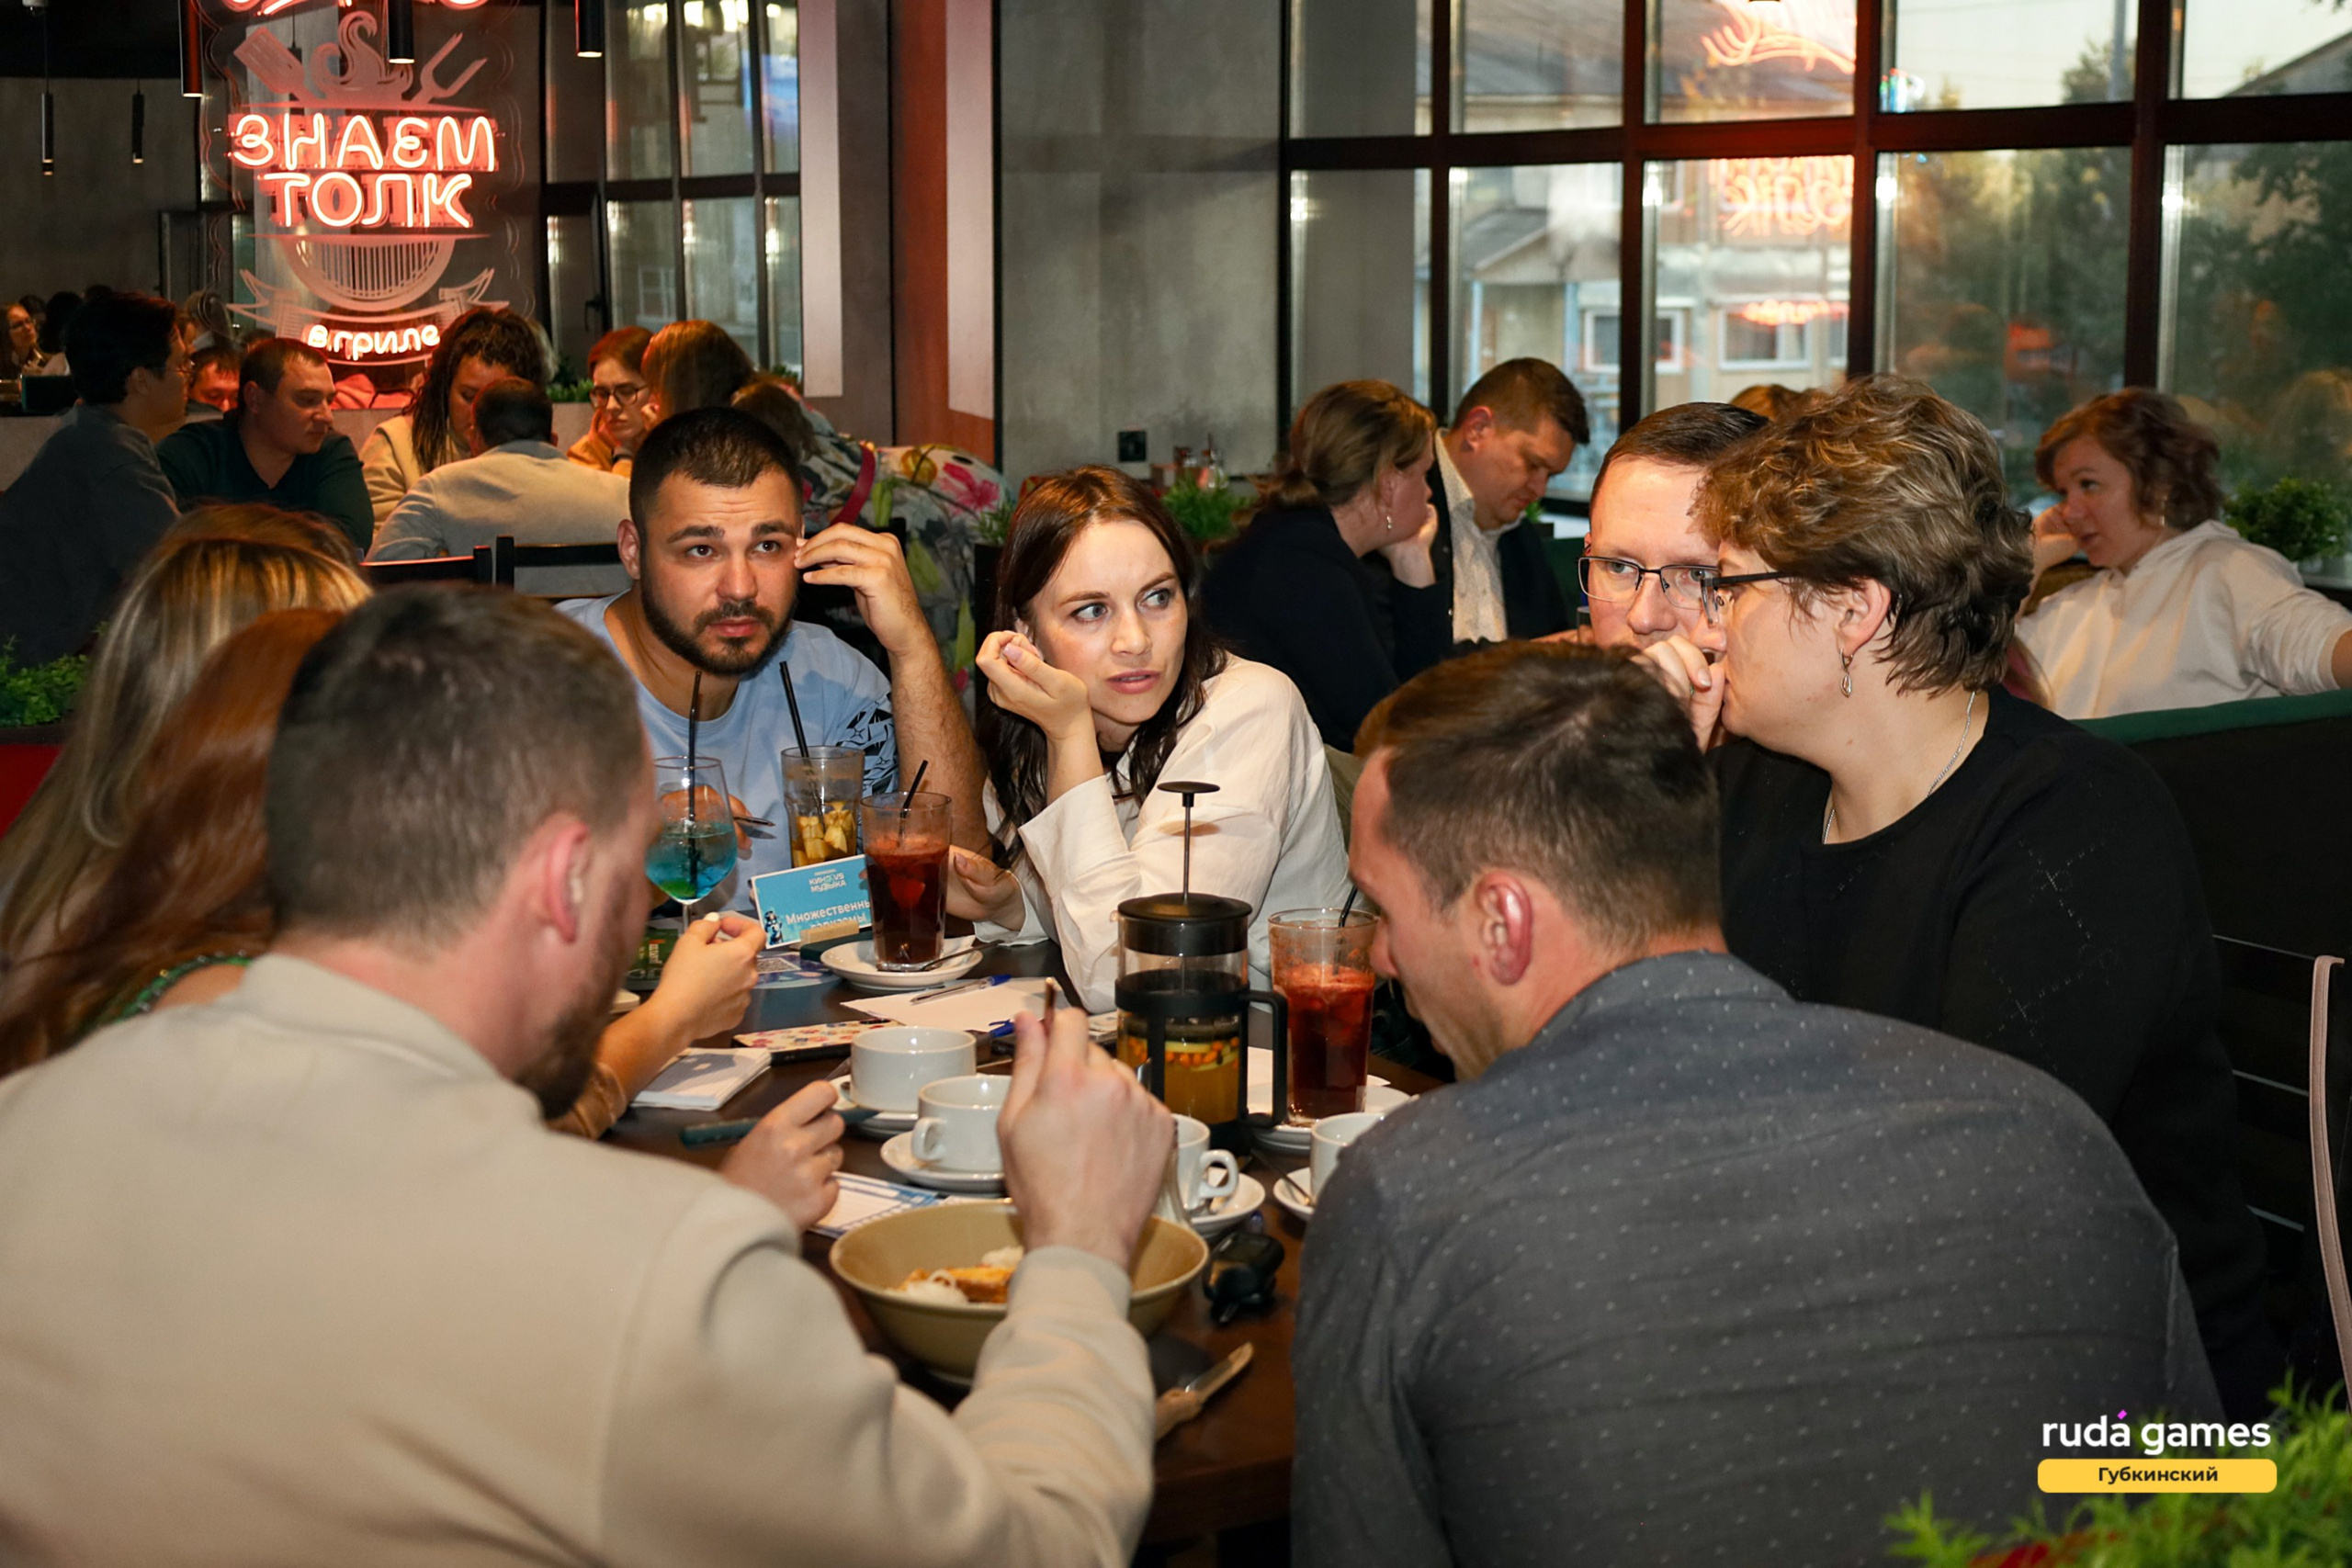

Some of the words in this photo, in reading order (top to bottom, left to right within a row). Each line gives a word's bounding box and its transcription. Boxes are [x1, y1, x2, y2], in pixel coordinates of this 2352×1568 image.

[231, 112, 496, 172] ЗНАЕМ
[262, 171, 473, 229] ТОЛК
[809, 879, 847, 893] МУЗЫКА
[785, 899, 871, 925] Множественны
